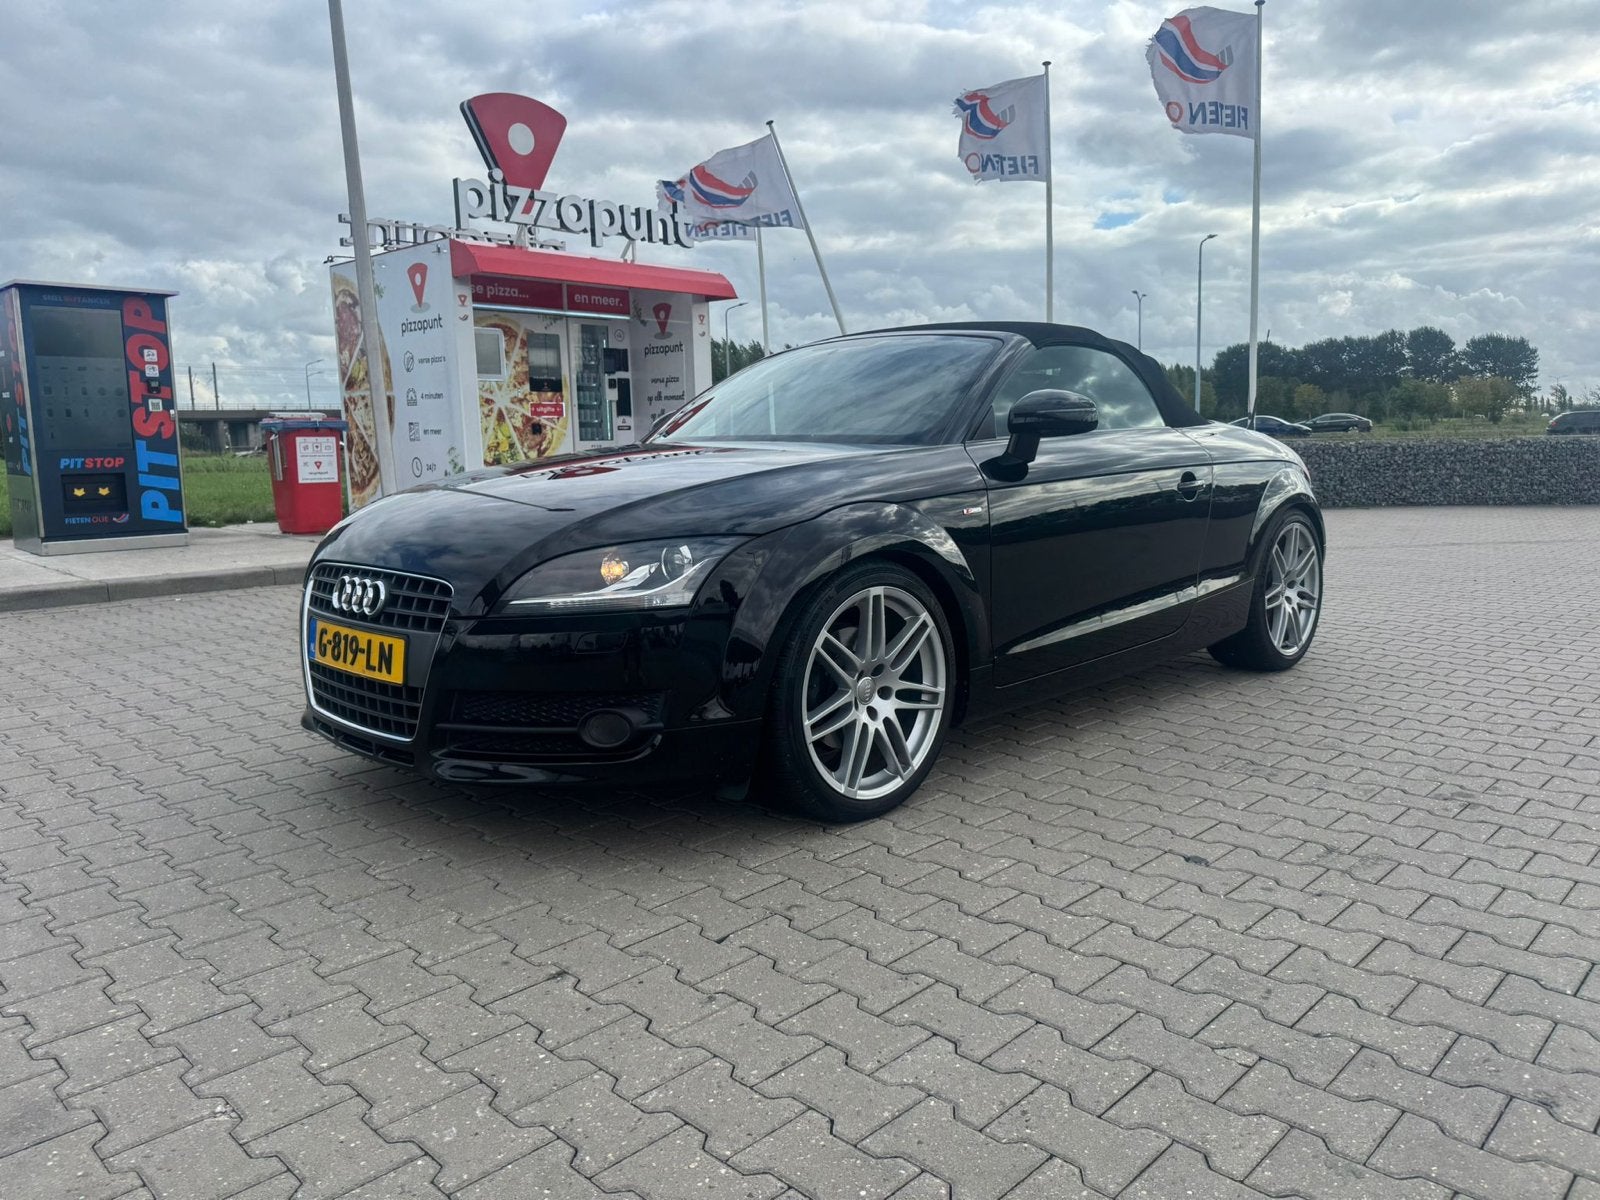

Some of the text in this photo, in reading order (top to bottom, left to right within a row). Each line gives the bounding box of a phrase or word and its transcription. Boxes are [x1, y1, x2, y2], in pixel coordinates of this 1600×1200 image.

[453, 167, 694, 248] pizzapunt
[574, 294, 623, 307] en meer.
[401, 313, 443, 337] pizzapunt
[644, 341, 684, 357] pizzapunt
[123, 296, 183, 523] PITSTOP
[60, 457, 125, 470] PITSTOP
[426, 464, 436, 472] 24/7
[65, 516, 92, 524] FIETEN
[318, 627, 394, 676] G-819-LN
